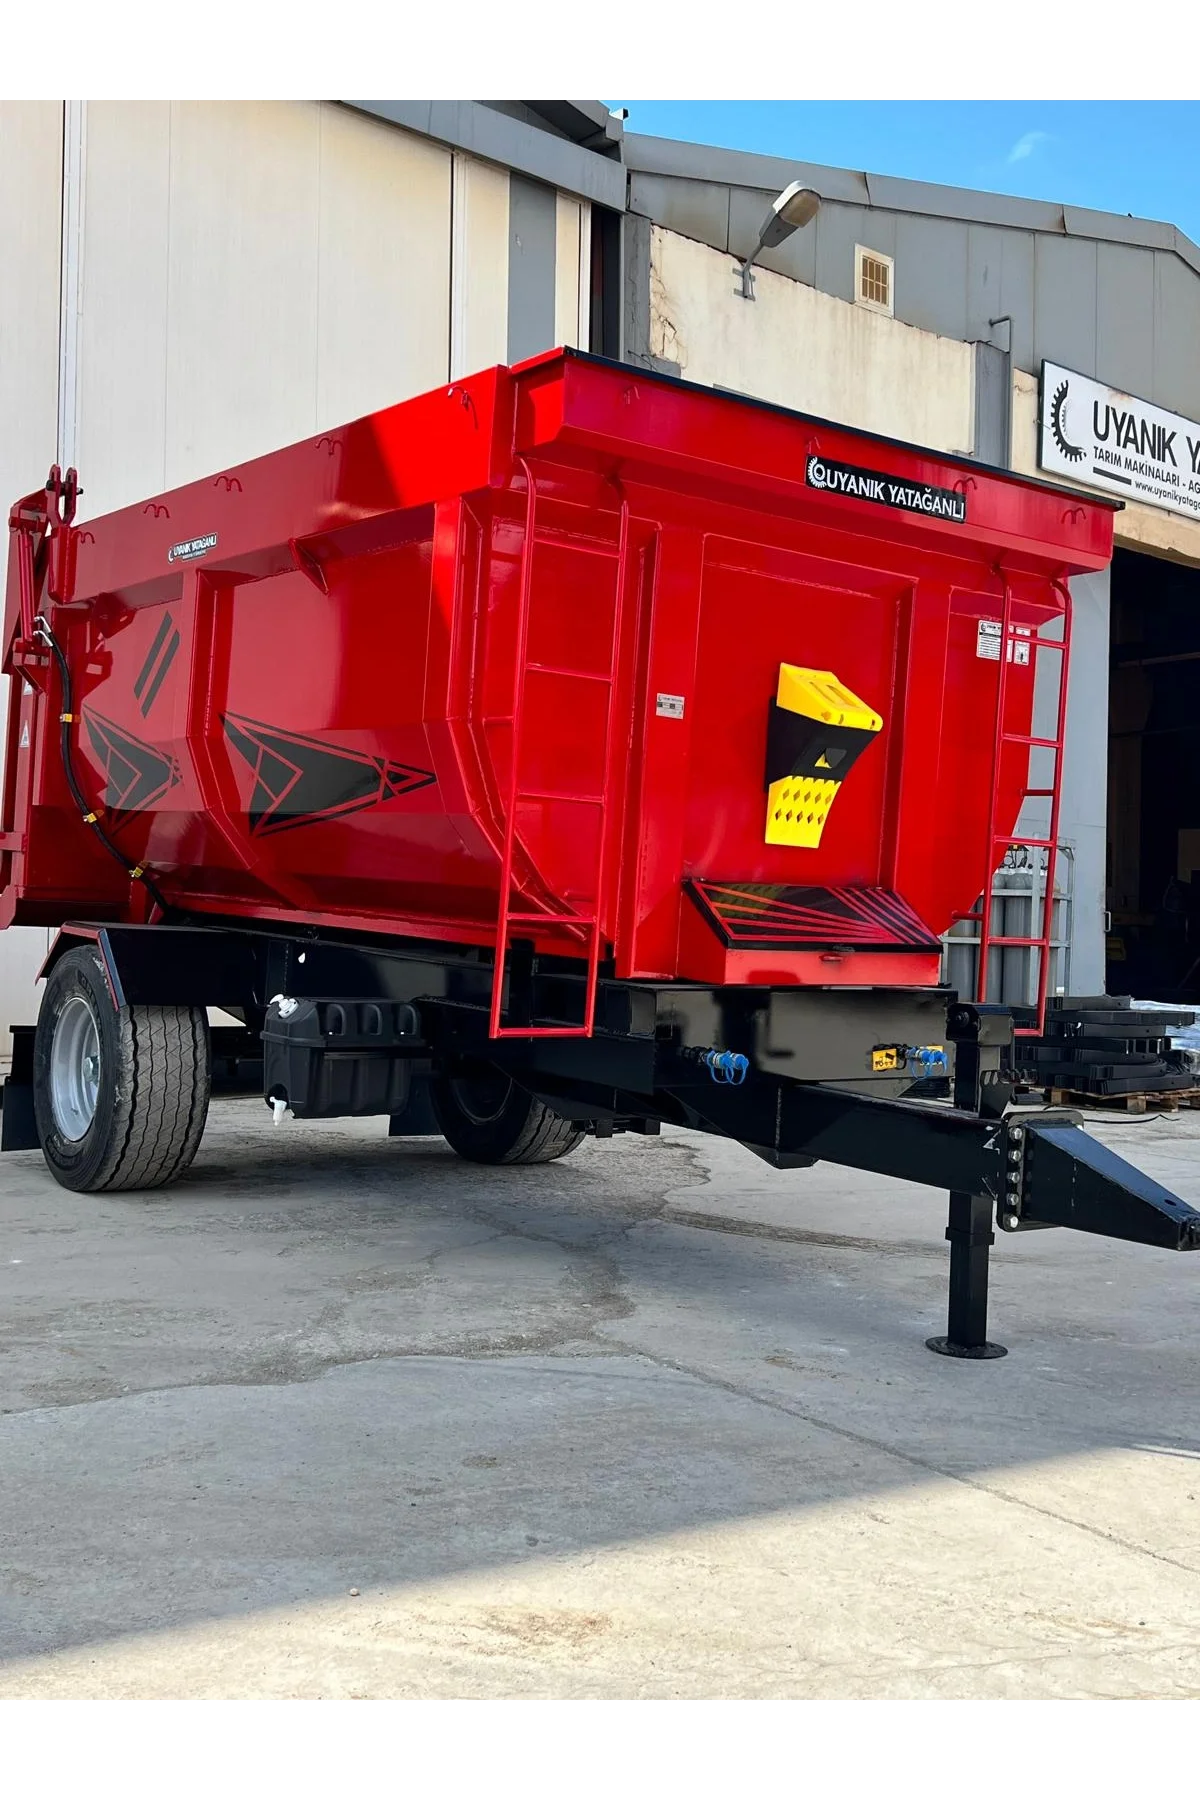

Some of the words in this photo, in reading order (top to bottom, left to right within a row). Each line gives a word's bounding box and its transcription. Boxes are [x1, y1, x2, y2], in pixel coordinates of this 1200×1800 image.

[1093, 400, 1178, 468] UYANIK
[1185, 435, 1200, 475] Y
[1093, 445, 1122, 468] TARIM
[1124, 456, 1180, 487] MAKİNALARI
[826, 469, 886, 501] UYANIK
[888, 484, 965, 519] YATAĞANLI
